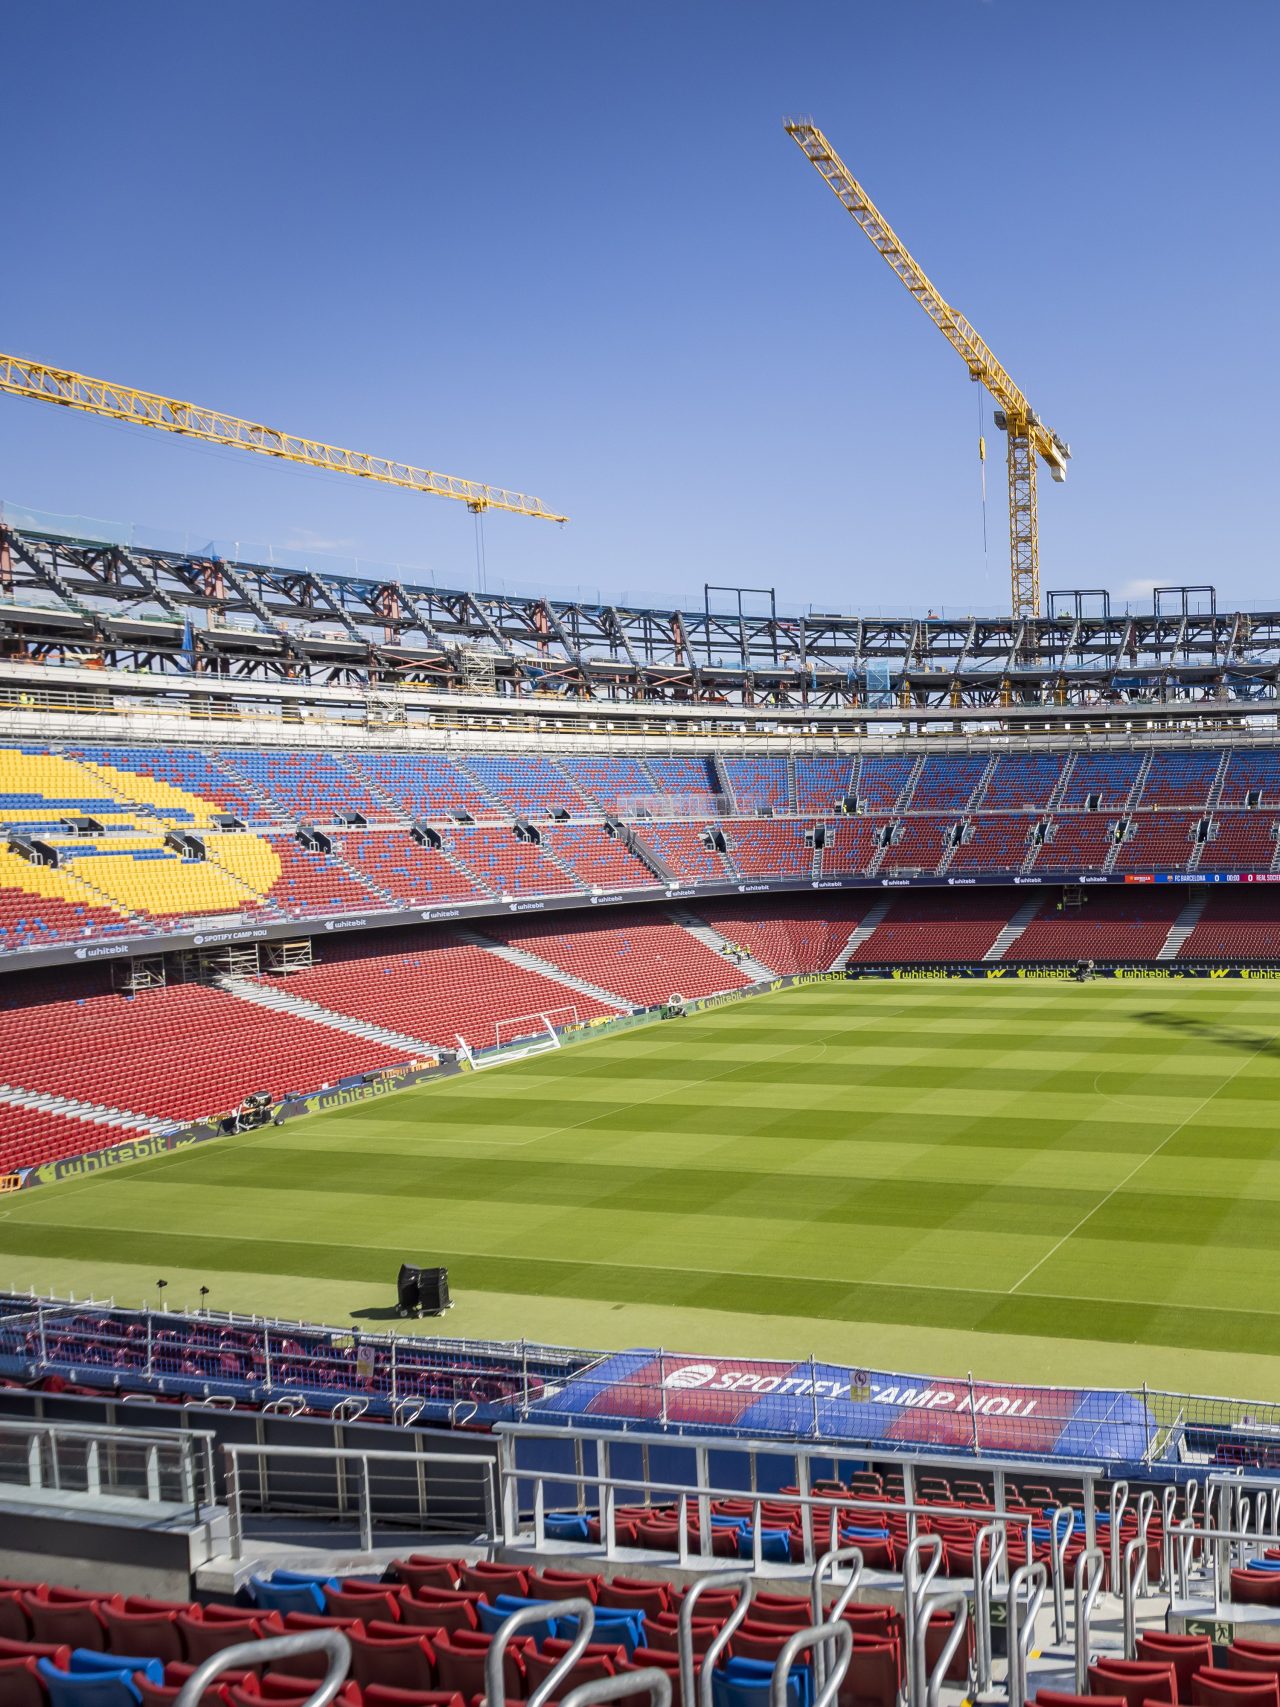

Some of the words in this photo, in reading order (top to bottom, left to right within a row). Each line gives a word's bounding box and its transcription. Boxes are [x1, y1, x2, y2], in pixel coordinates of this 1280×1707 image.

[746, 884, 769, 892] whitebit
[672, 889, 695, 897] whitebit
[597, 895, 622, 903] whitebit
[517, 902, 544, 910] whitebit
[430, 910, 459, 919] whitebit
[335, 919, 366, 929] whitebit
[204, 933, 232, 942] SPOTIFY
[233, 931, 251, 940] CAMP
[252, 929, 267, 938] NOU
[88, 945, 129, 957] whitebit
[800, 971, 847, 983] whitebit
[902, 970, 947, 979] whitebit
[1026, 969, 1070, 978] whitebit
[1123, 969, 1170, 978] whitebit
[706, 992, 742, 1007] whitebit
[323, 1079, 397, 1107] whitebit
[61, 1138, 166, 1177] whitebit
[710, 1372, 850, 1401] SPOTIFY
[867, 1384, 955, 1409] AMP
[955, 1395, 1037, 1416] NOU
